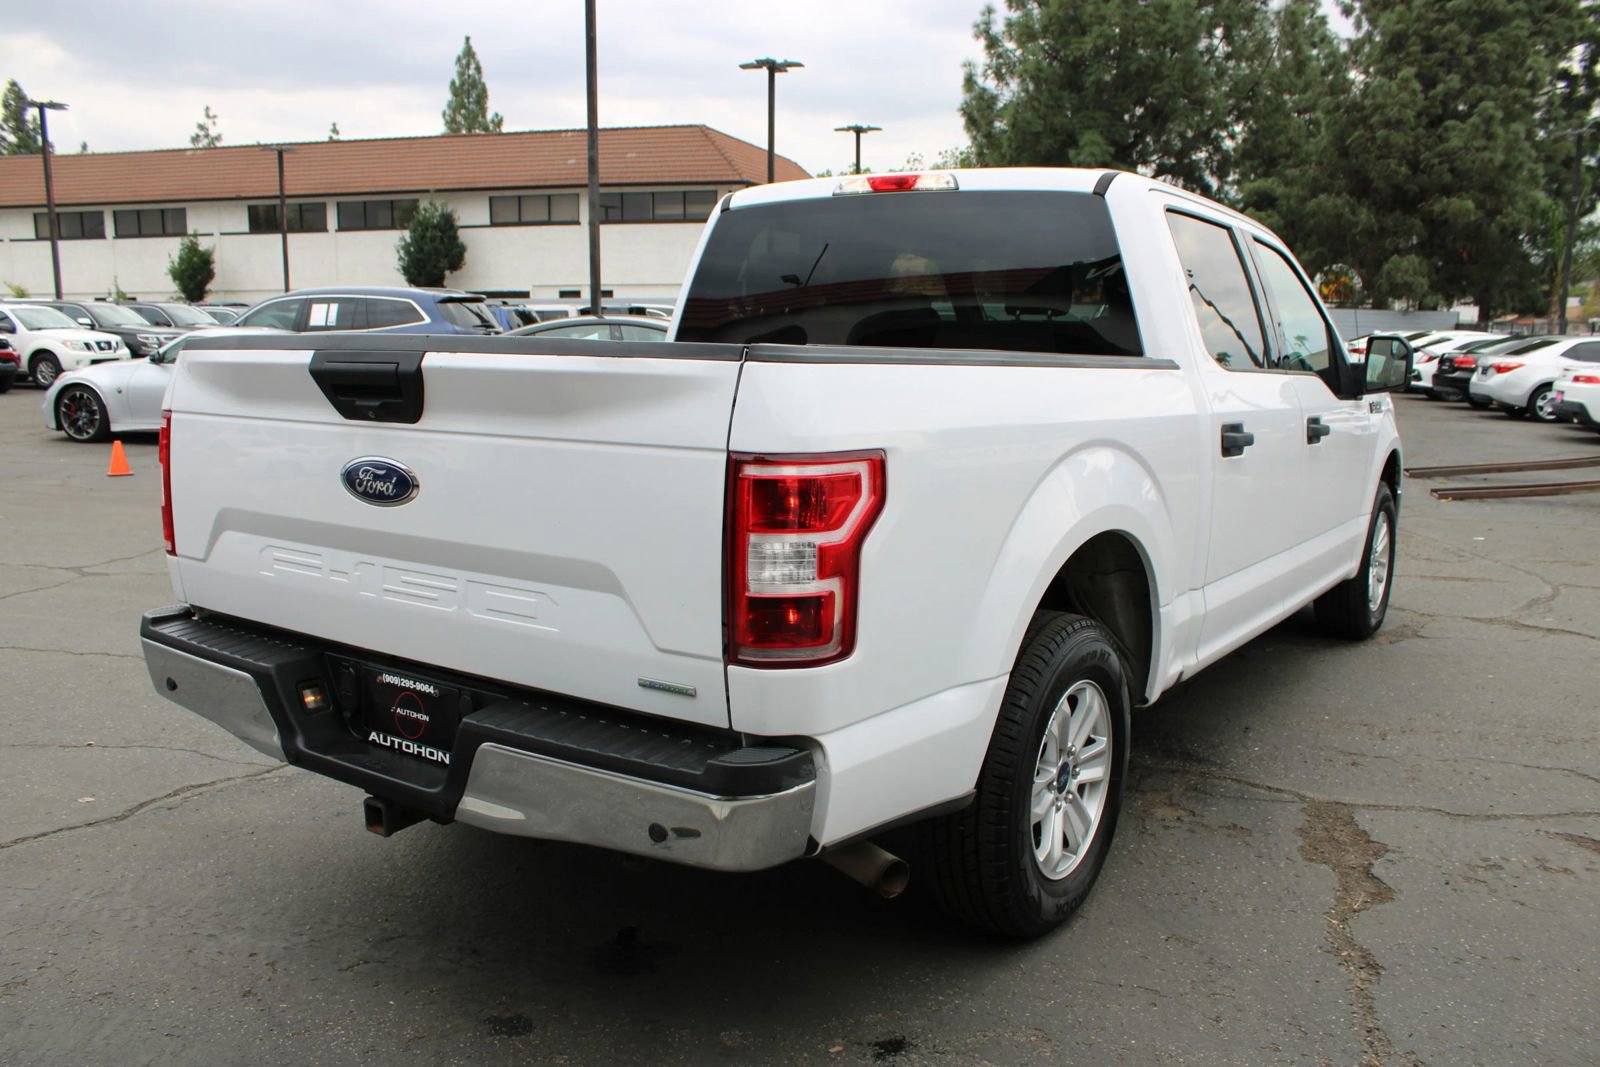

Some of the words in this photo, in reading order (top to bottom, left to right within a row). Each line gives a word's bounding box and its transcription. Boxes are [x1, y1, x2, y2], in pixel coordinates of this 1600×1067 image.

[355, 466, 398, 496] Ford
[258, 545, 560, 632] F-150
[396, 707, 430, 722] AUTOHON
[368, 731, 450, 765] AUTOHON
